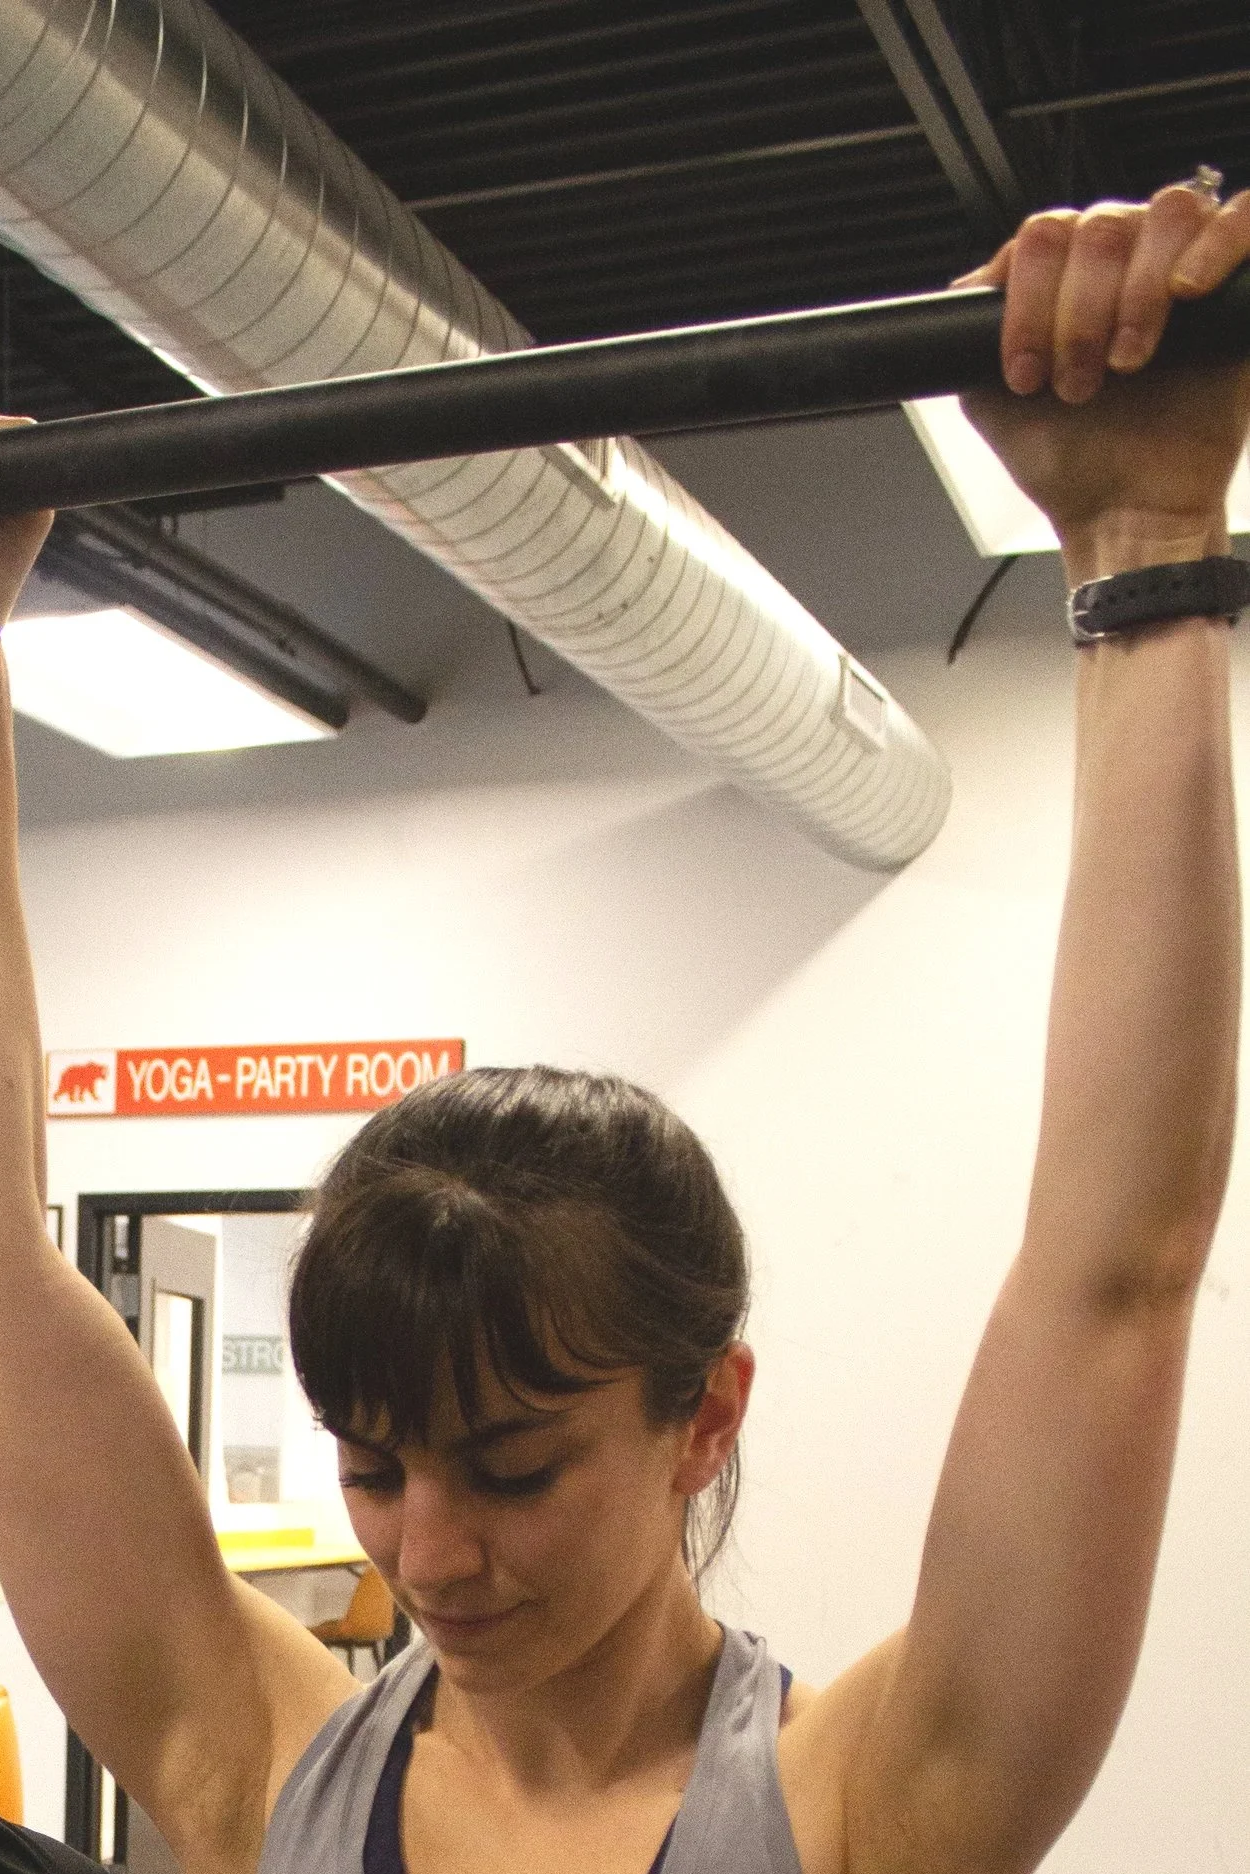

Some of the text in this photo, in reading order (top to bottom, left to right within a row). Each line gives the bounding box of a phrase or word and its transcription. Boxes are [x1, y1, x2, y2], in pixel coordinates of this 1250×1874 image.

[128, 1056, 213, 1102] YOGA
[236, 1054, 337, 1099] PARTY
[347, 1051, 448, 1097] ROOM
